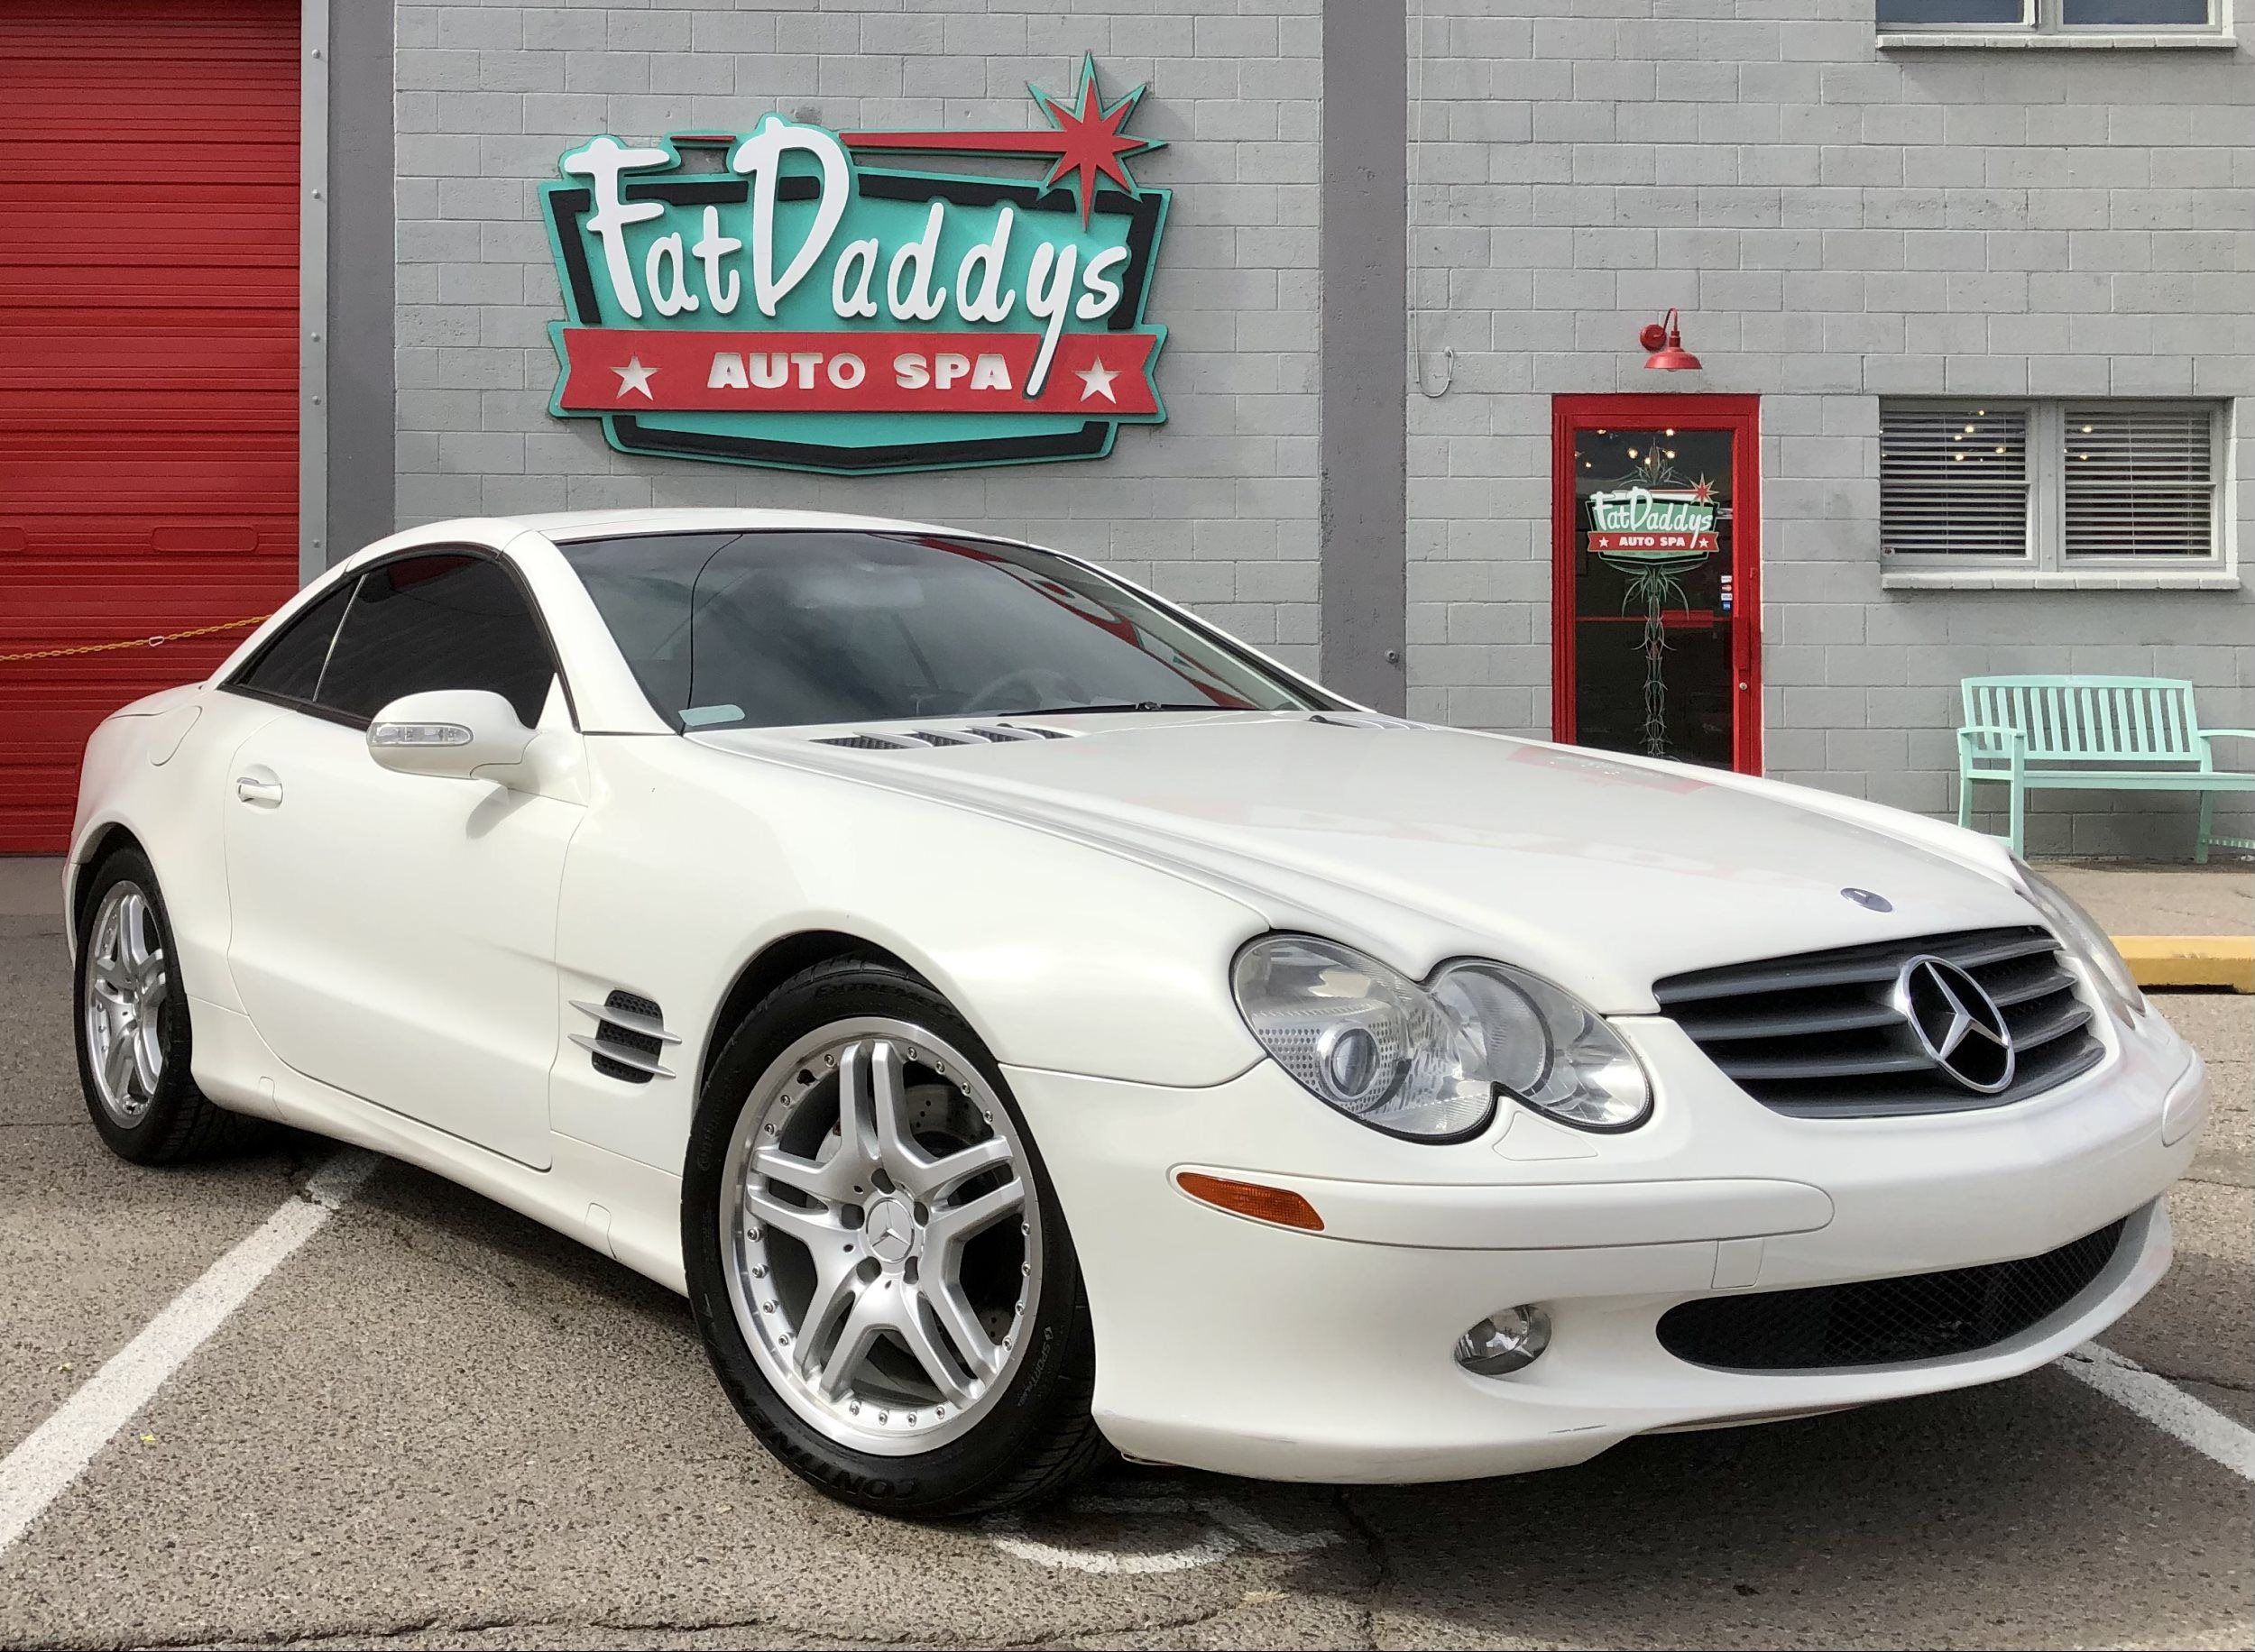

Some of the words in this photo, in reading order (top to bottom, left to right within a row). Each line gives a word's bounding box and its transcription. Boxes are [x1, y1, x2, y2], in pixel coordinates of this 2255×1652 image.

[564, 138, 743, 318] Fat
[732, 116, 1128, 396] Daddys
[707, 352, 866, 390] AUTO
[893, 352, 1013, 390] SPA
[1589, 491, 1631, 531] Fat
[1626, 486, 1714, 549] Daddys
[1619, 537, 1655, 546] AUTO
[1660, 537, 1685, 546] SPA
